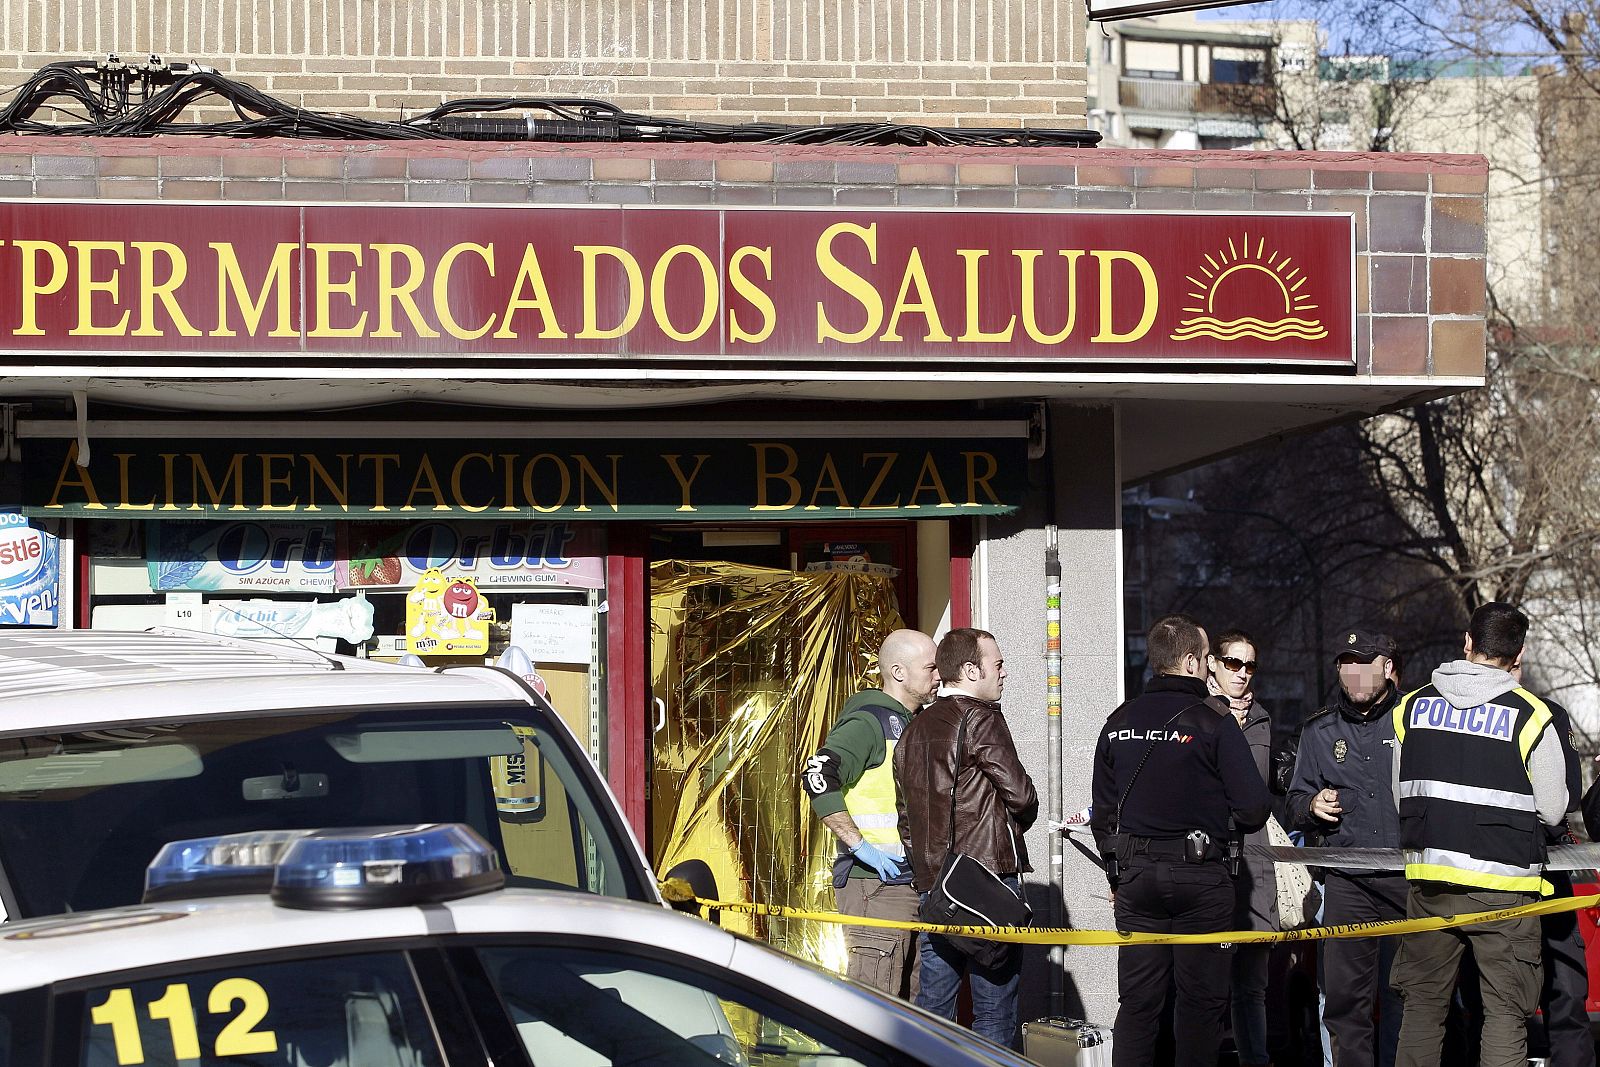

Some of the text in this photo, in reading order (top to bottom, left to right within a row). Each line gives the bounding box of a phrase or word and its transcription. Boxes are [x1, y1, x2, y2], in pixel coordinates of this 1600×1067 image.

[0, 221, 1159, 345] PERMERCADOS SALUD
[44, 440, 1007, 513] ALIMENTACION Y BAZAR
[403, 522, 577, 574] Orbit
[255, 576, 291, 585] AZÚCAR
[489, 575, 532, 583] CHEWING
[535, 574, 557, 582] GUM
[177, 610, 192, 618] L10
[1107, 728, 1181, 743] POLICIA
[1412, 698, 1511, 738] POLICIA
[91, 977, 278, 1066] 112
